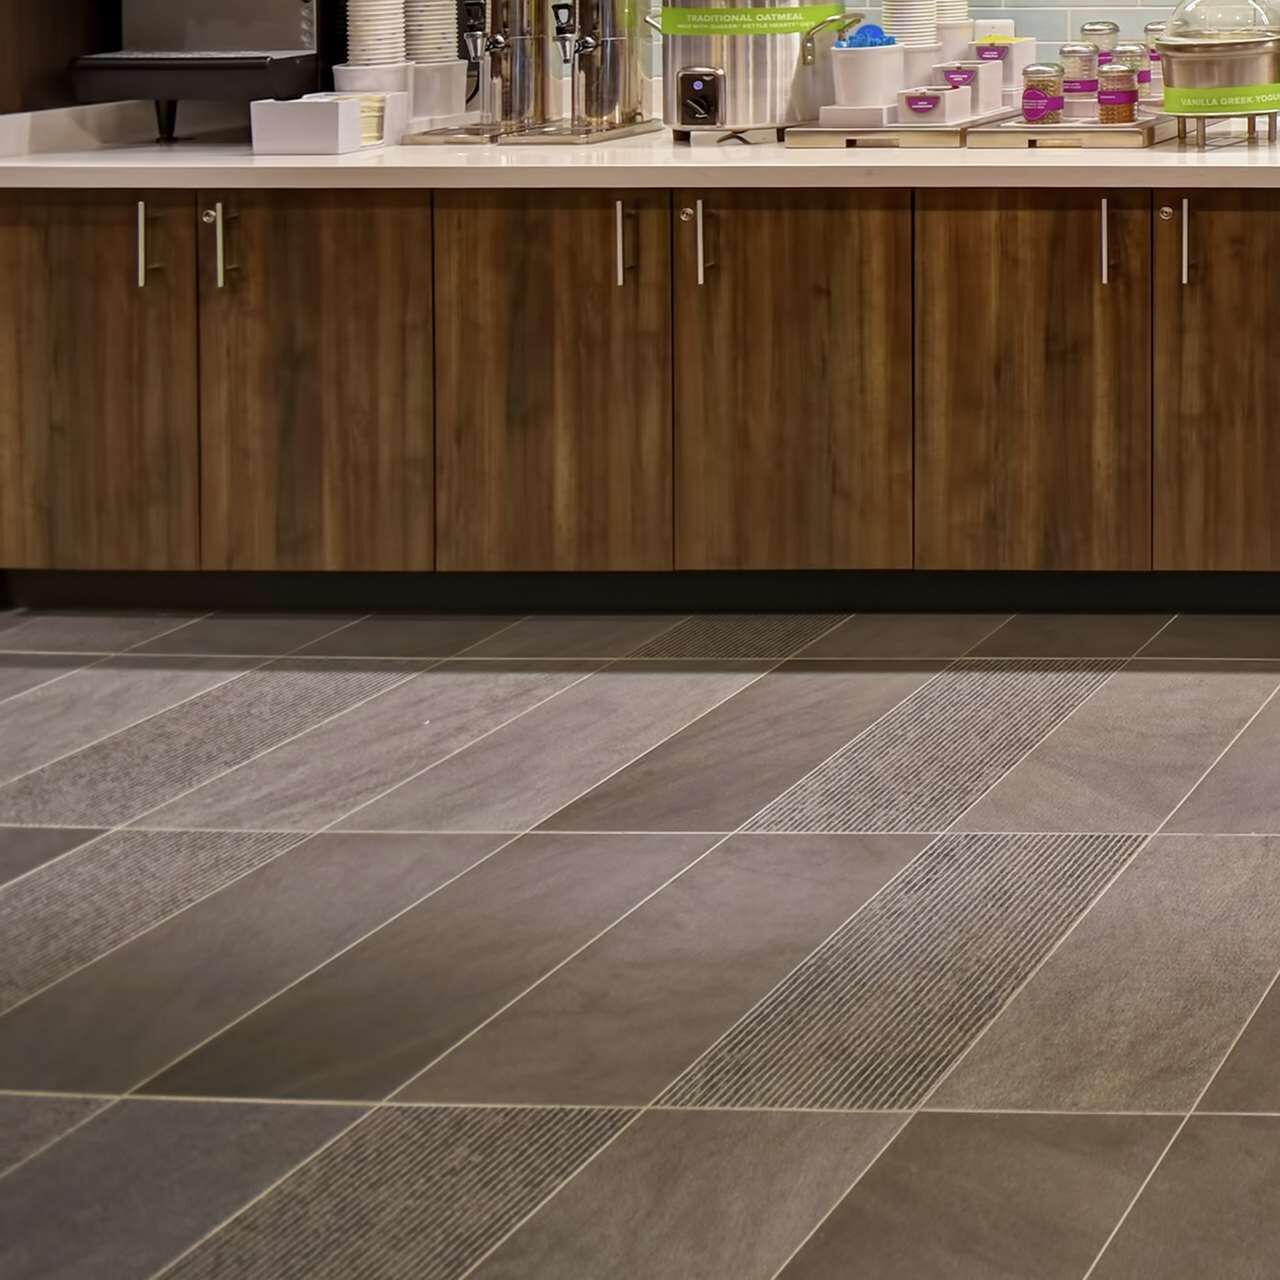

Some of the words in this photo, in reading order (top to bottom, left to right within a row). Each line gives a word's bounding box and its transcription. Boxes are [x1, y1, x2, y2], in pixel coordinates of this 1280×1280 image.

[687, 14, 752, 23] TRADITIONAL
[756, 13, 803, 22] OATMEAL
[1180, 98, 1218, 106] VANILLA
[1220, 97, 1254, 105] GREEK
